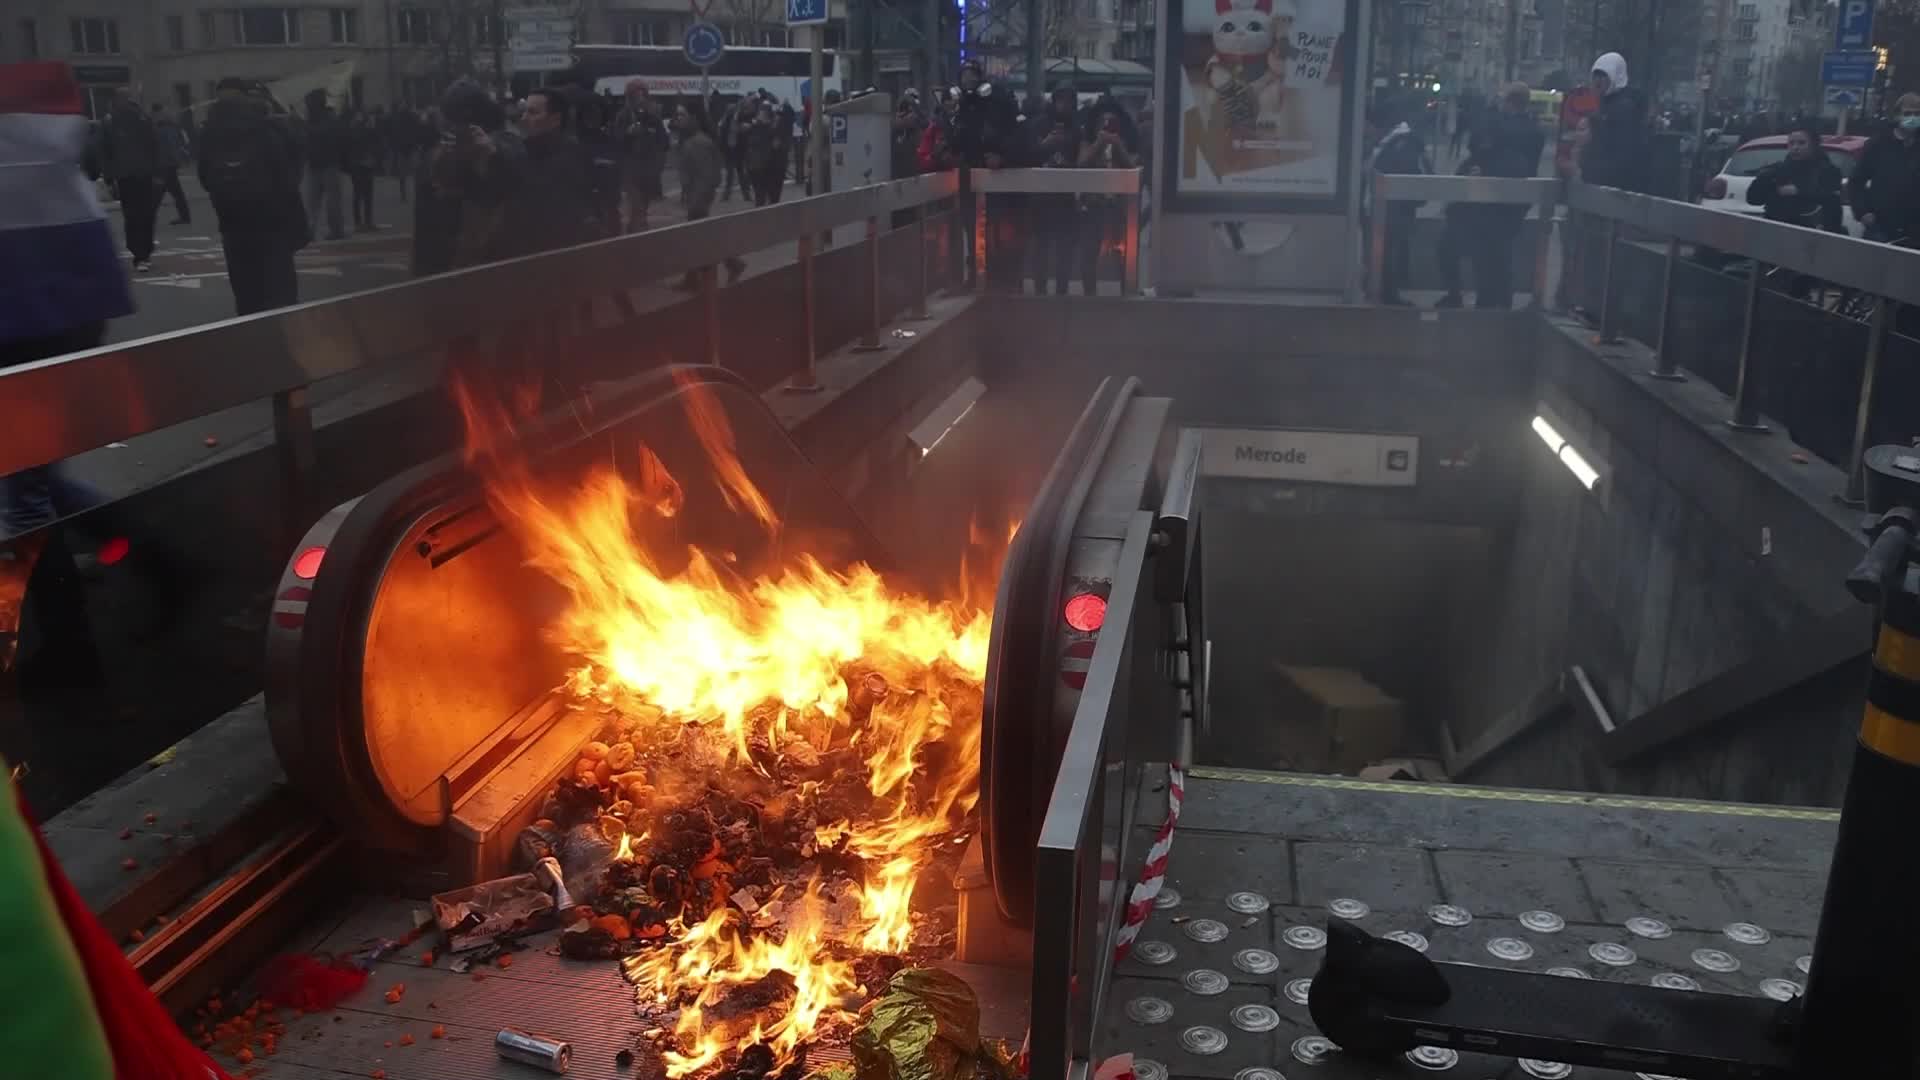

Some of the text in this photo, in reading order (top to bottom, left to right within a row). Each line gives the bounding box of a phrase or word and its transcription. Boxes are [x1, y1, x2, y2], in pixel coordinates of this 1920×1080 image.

[1844, 1, 1866, 29] P
[832, 116, 846, 138] P
[1235, 446, 1306, 464] Merode
